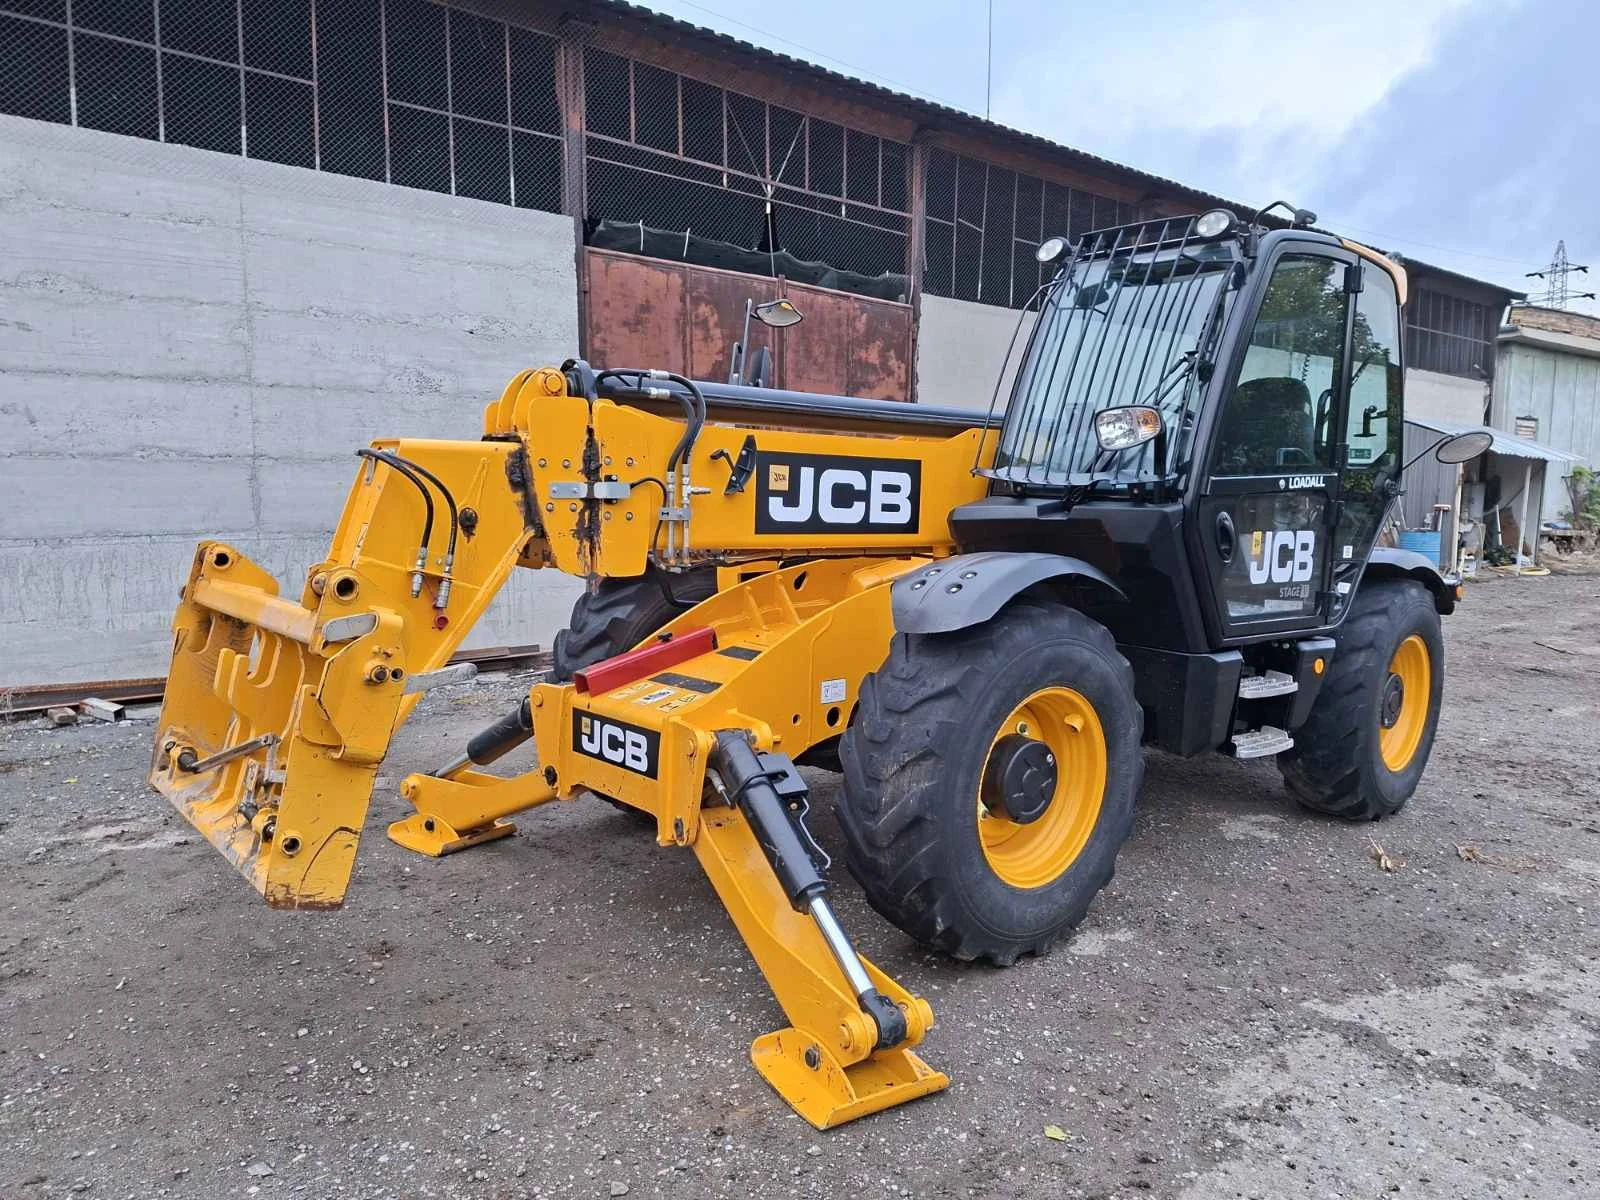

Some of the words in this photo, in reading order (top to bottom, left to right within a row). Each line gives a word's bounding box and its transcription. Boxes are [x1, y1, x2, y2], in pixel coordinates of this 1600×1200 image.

[768, 466, 912, 524] JCB
[1289, 477, 1325, 488] LOADALL
[1250, 530, 1315, 585] JCB
[1279, 586, 1300, 598] STAGE
[581, 719, 648, 772] JCB
